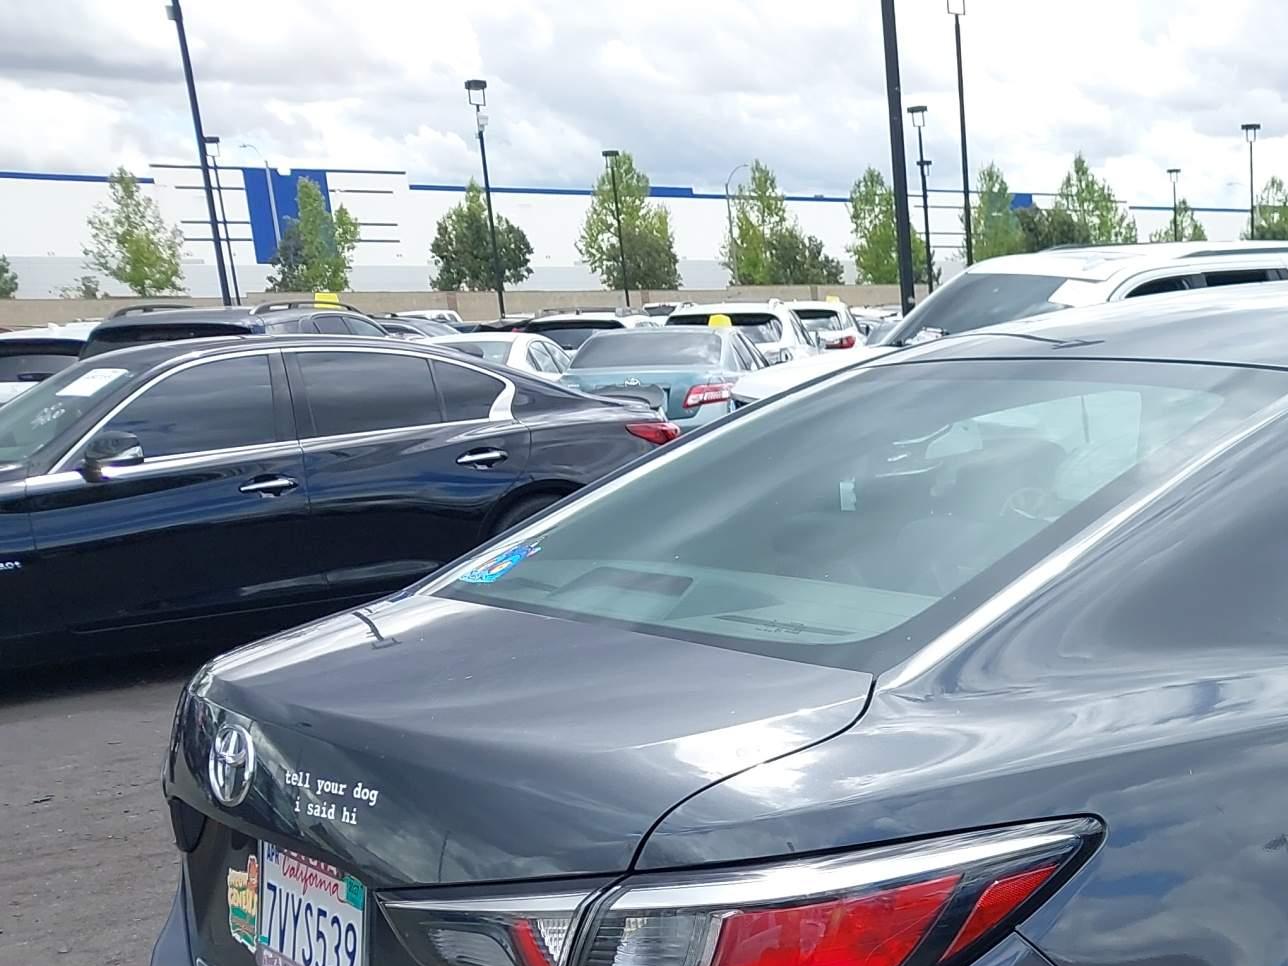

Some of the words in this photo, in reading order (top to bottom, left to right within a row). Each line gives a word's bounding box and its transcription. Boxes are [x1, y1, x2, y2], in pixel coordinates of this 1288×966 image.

[285, 770, 310, 788] tell
[316, 779, 347, 795] your
[353, 782, 379, 806] dog
[295, 796, 301, 812] i
[307, 802, 335, 820] said
[342, 807, 357, 825] hi
[281, 855, 346, 903] California
